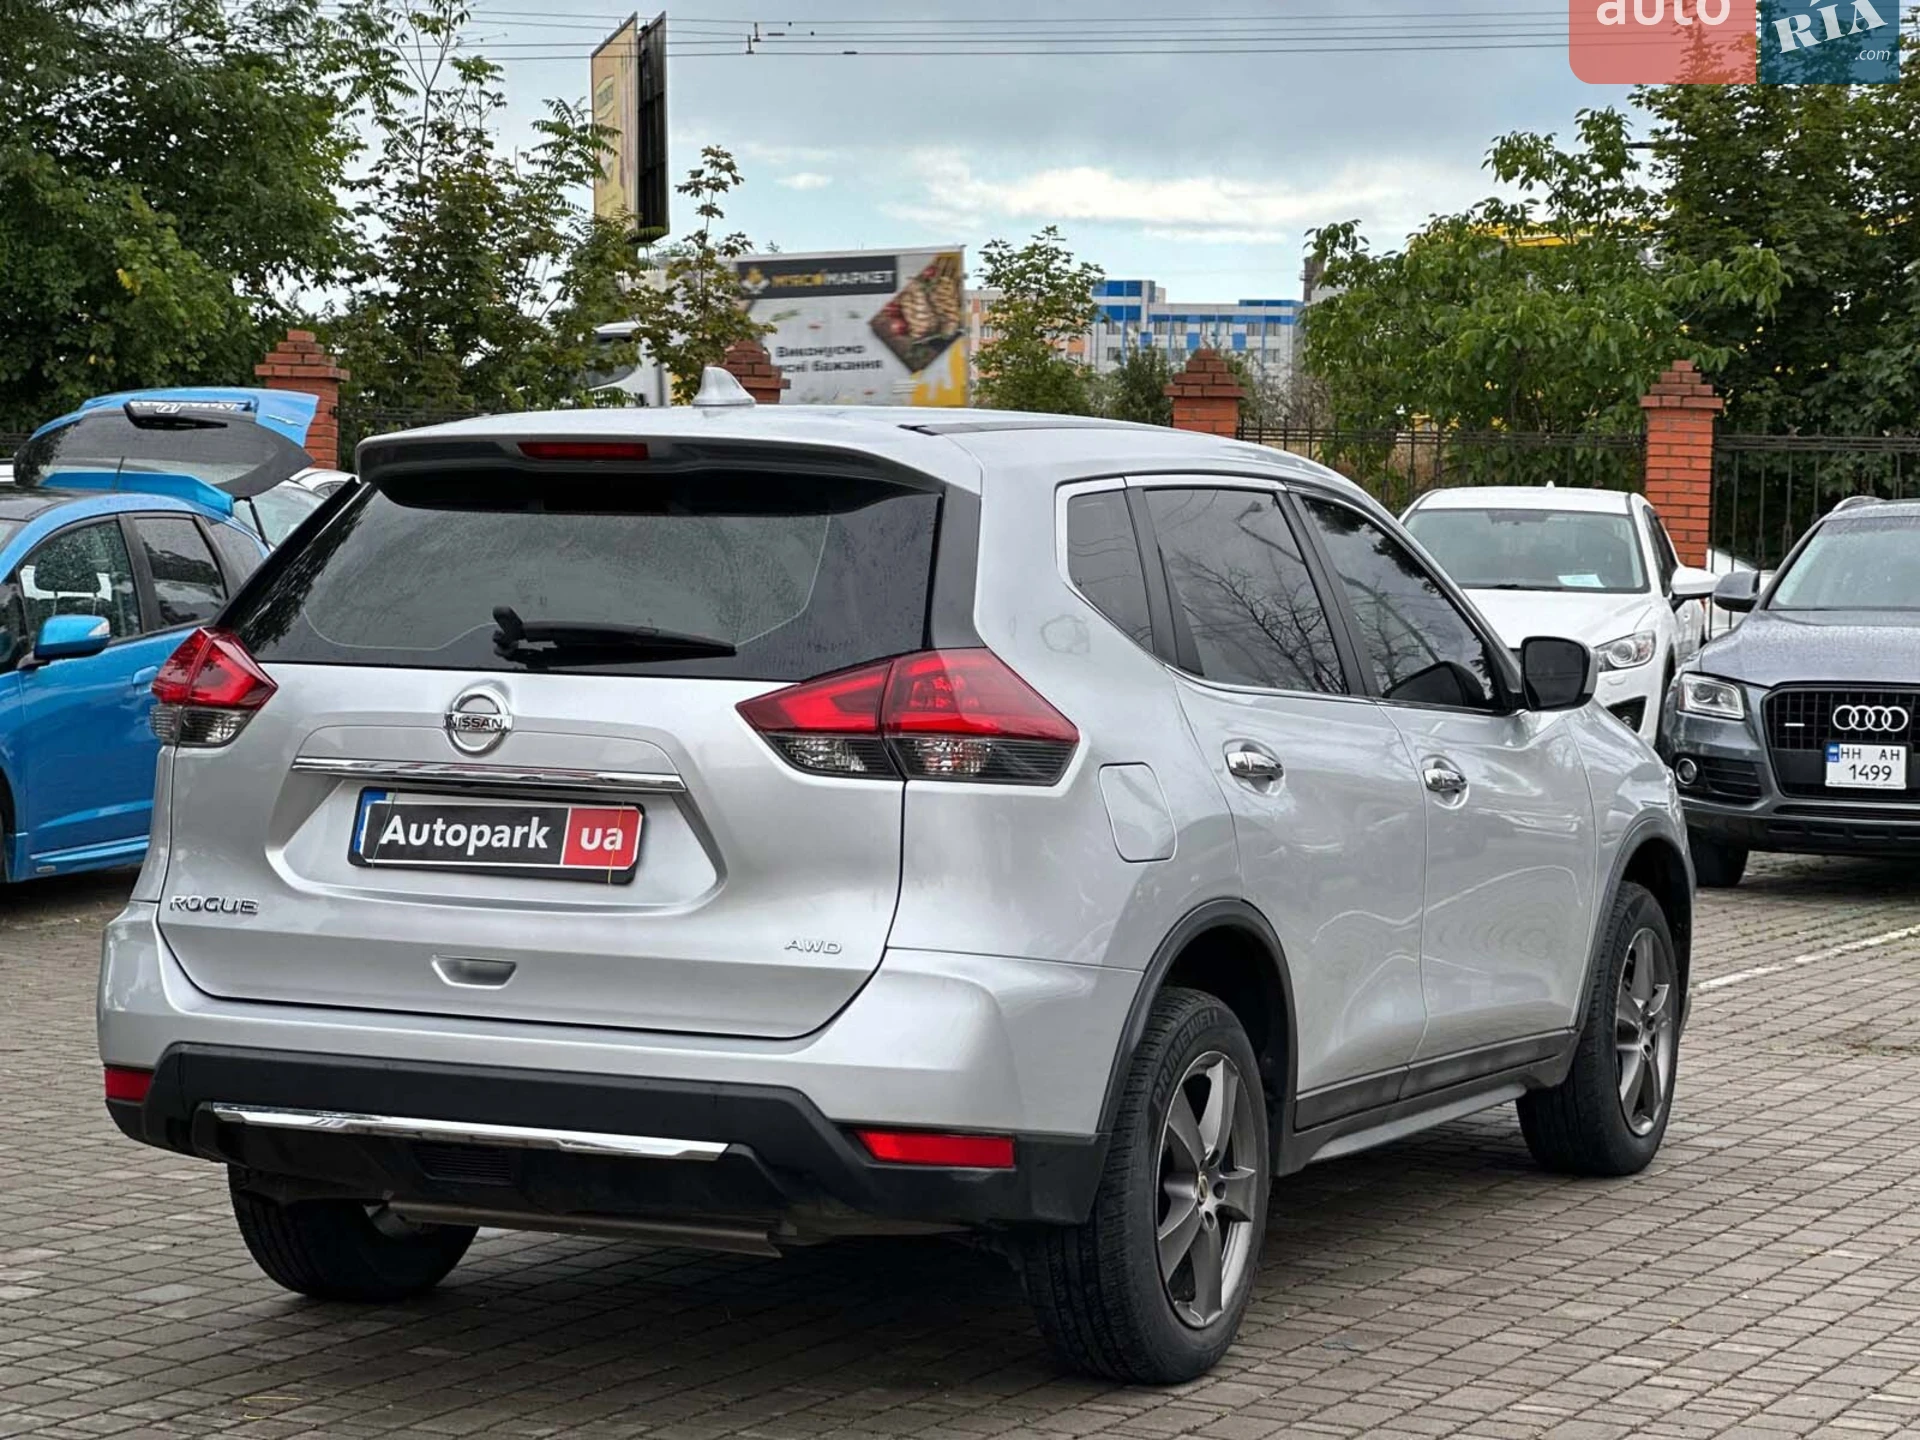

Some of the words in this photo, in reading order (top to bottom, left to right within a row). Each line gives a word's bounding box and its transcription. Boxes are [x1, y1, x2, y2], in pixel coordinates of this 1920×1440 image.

[444, 713, 503, 729] NISSAN
[1848, 764, 1892, 782] 1499
[379, 814, 551, 856] Autopark
[580, 826, 623, 851] ua
[169, 895, 259, 915] ROGUE
[783, 938, 842, 955] AWD
